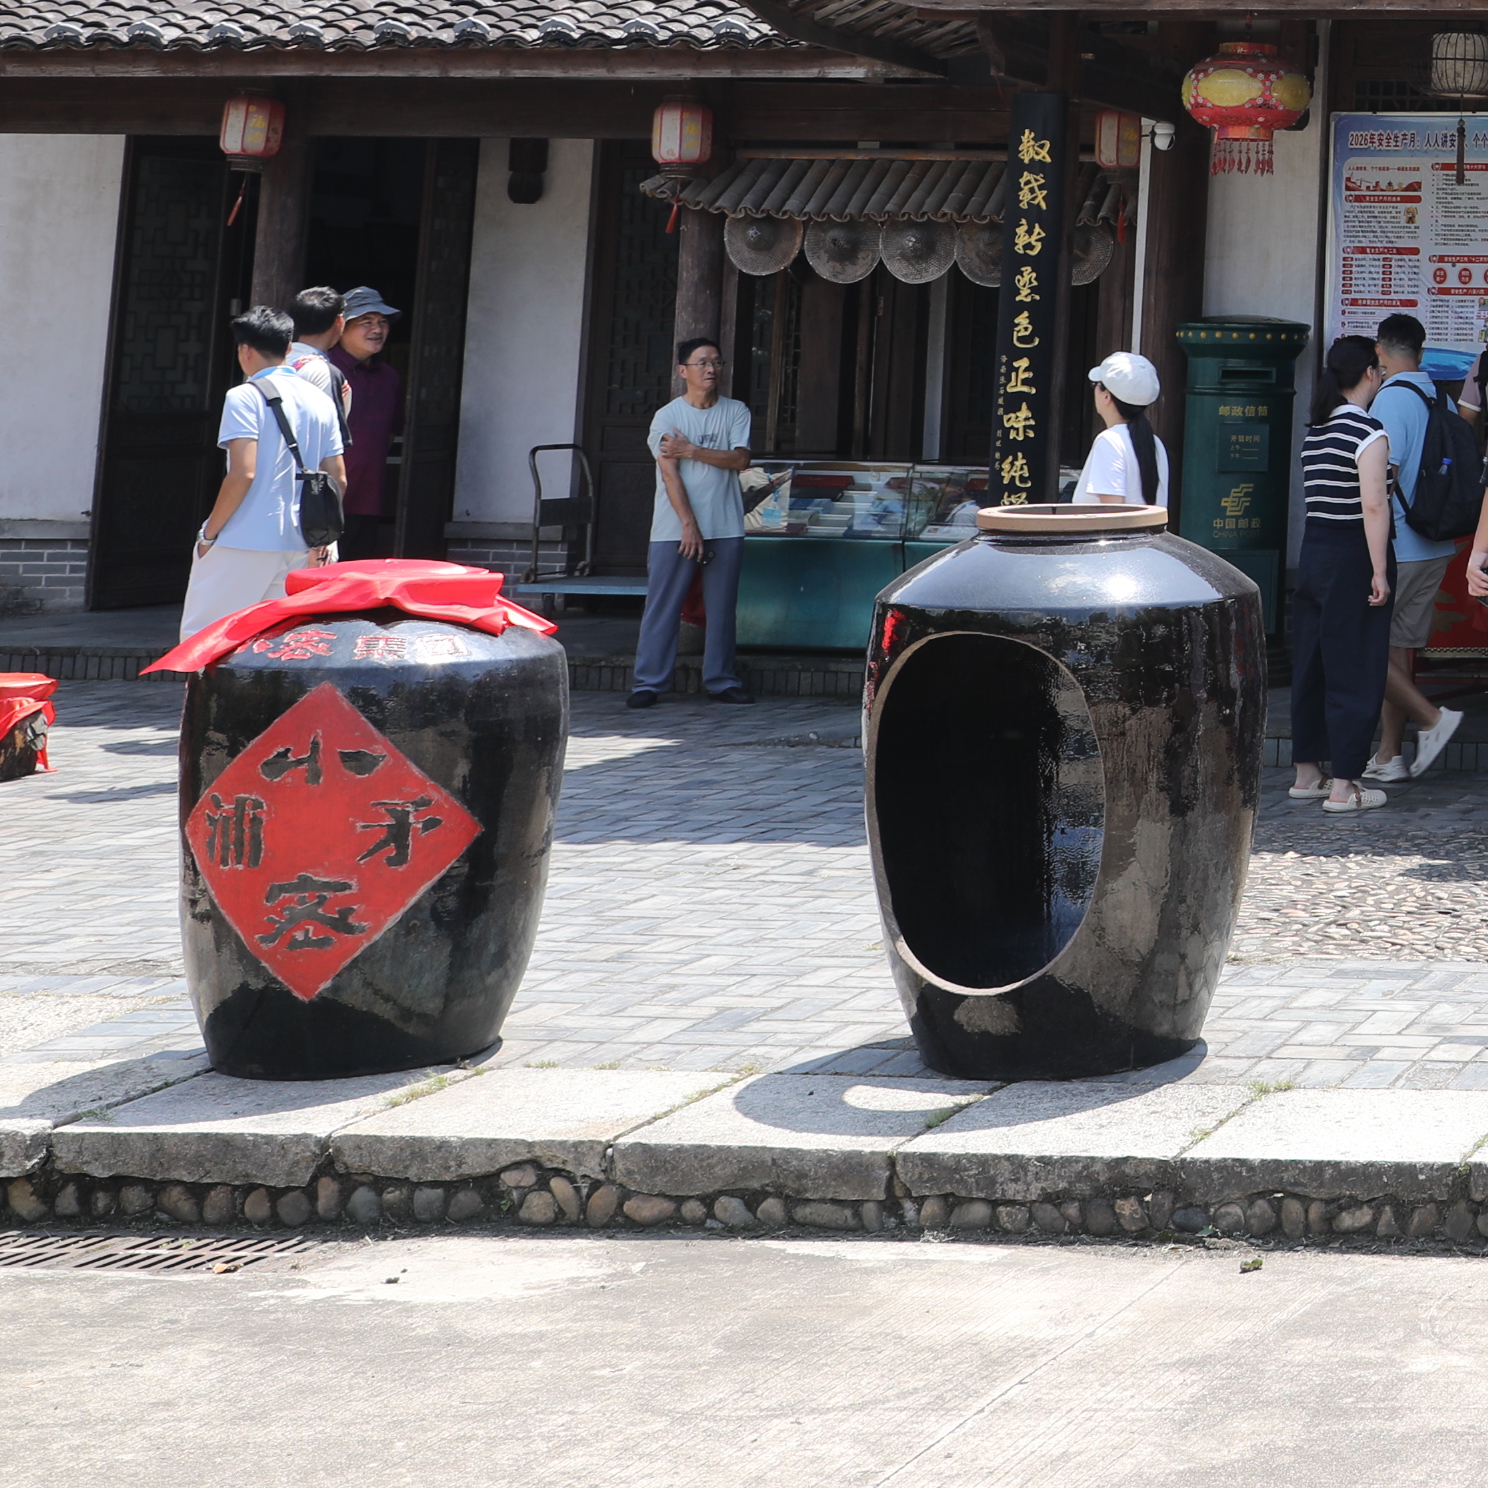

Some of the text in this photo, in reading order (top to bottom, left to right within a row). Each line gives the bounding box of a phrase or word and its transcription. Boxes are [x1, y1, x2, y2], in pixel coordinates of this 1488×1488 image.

[1218, 405, 1269, 417] 邮政信筒
[1213, 517, 1261, 529] 中国邮政
[1213, 530, 1237, 538] CHINA
